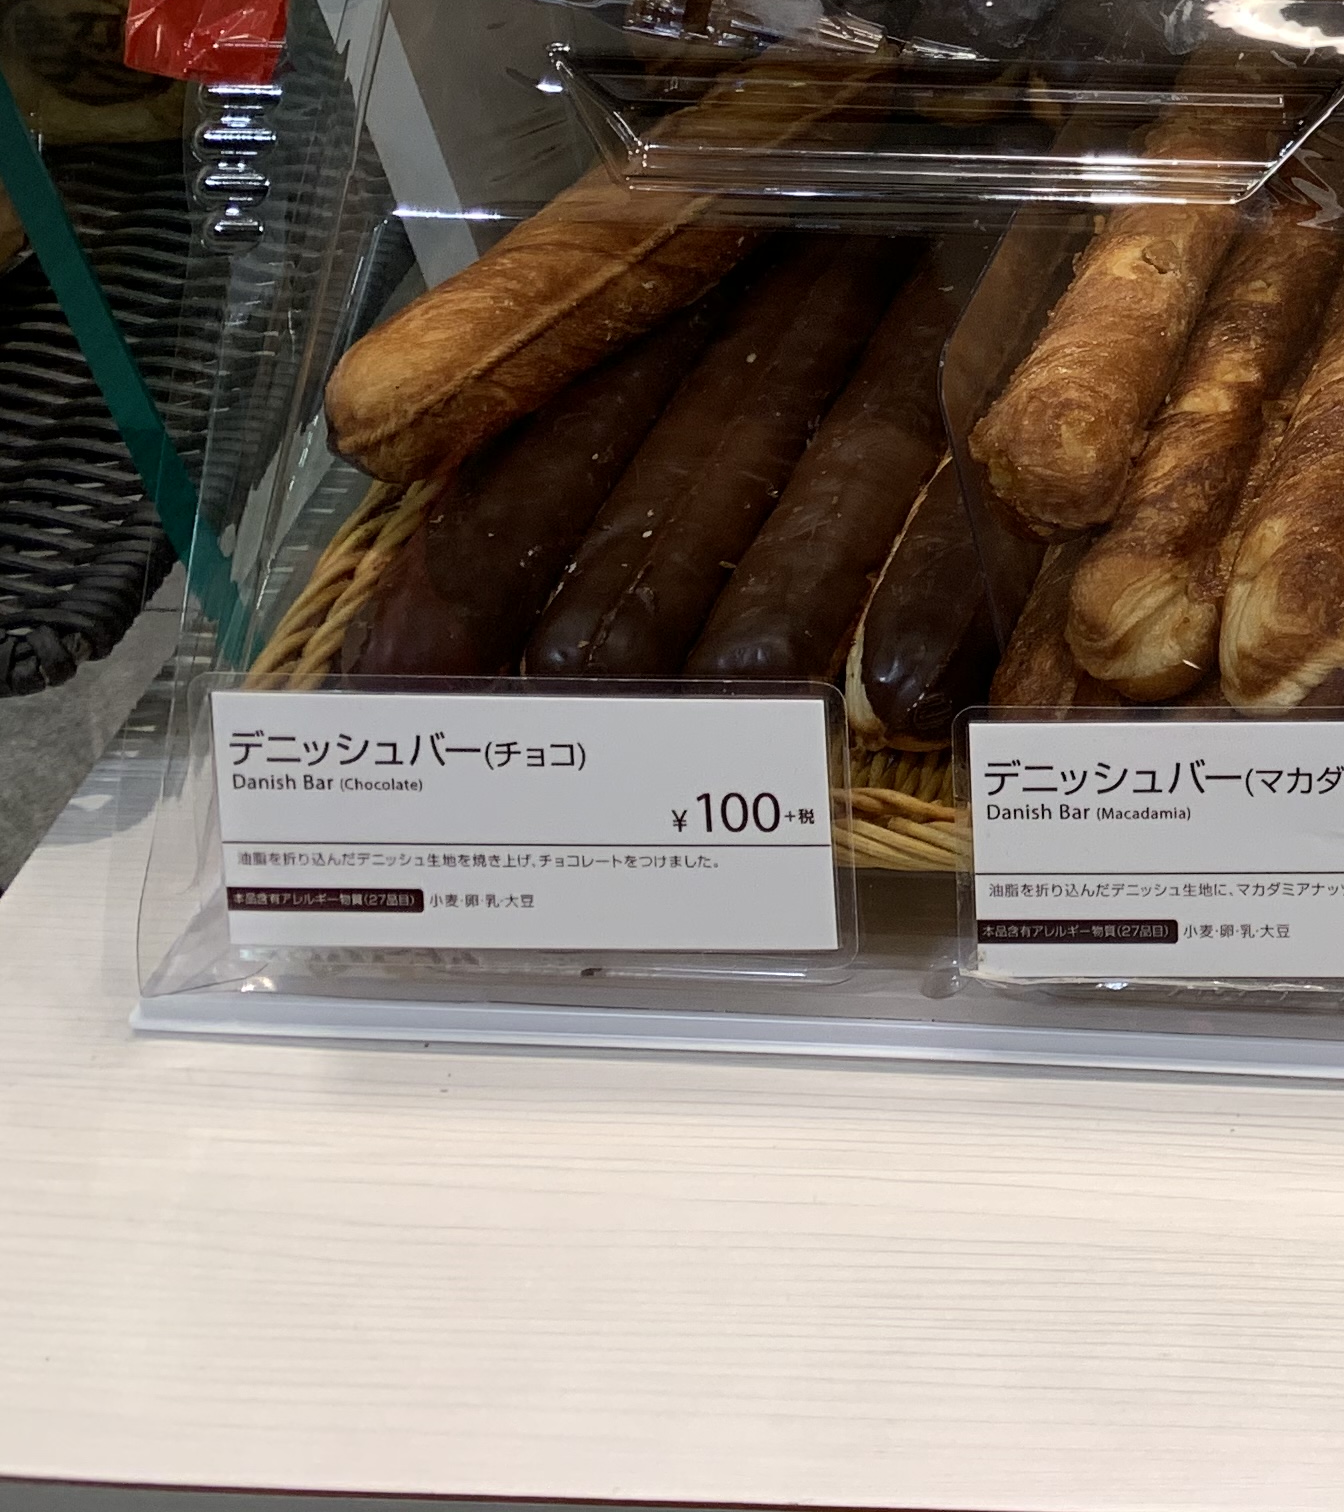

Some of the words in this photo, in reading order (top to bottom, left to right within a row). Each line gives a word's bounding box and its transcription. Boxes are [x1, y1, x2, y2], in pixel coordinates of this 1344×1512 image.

[228, 729, 587, 771] デニッシュバー(チョコ)
[232, 773, 297, 791] Danish
[303, 774, 335, 791] Bar
[339, 777, 424, 793] (Chocolate)
[986, 803, 1053, 821] Danish
[1059, 803, 1091, 821] Bar
[1095, 806, 1192, 823] (Macadamia)
